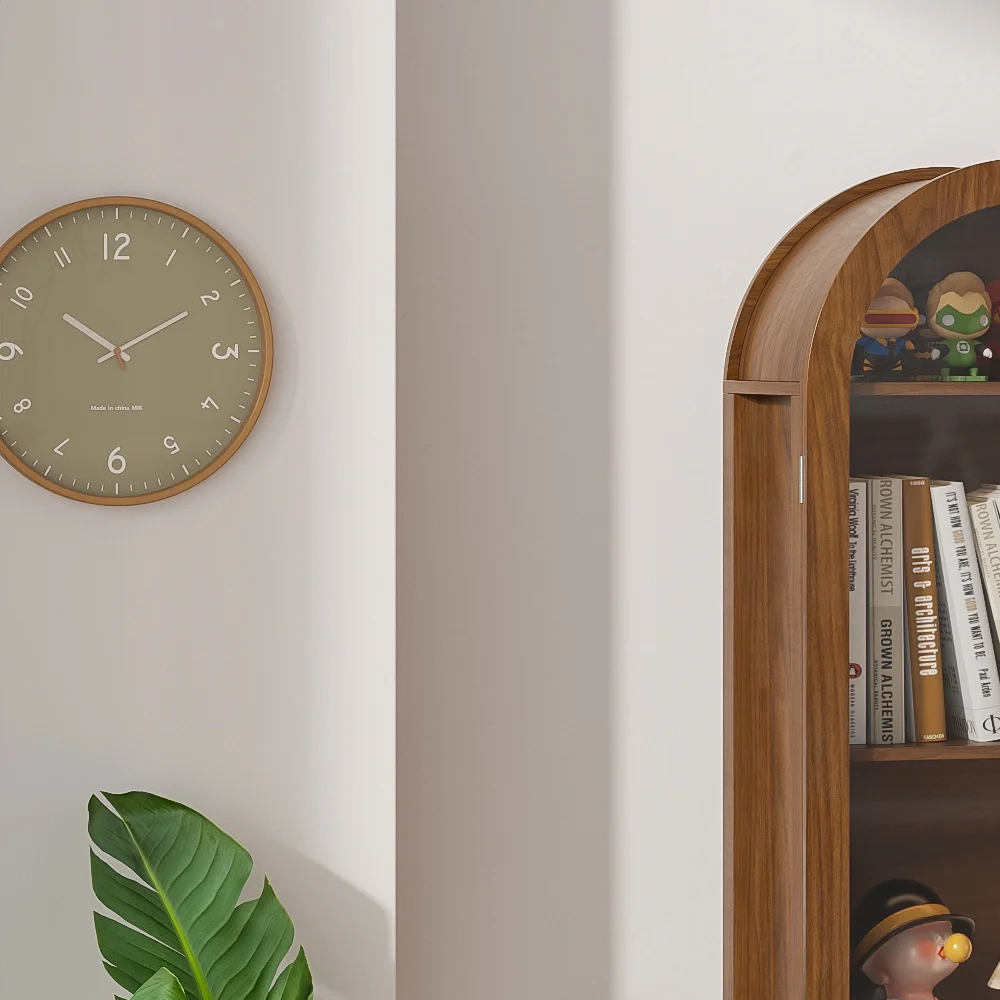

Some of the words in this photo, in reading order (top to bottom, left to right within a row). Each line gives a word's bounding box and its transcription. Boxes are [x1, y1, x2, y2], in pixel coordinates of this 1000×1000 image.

[103, 232, 131, 261] 12
[53, 246, 72, 268] 11
[9, 286, 34, 309] 10
[199, 289, 221, 307] 2
[0, 341, 24, 361] 9
[211, 342, 239, 360] 3
[13, 397, 32, 414] 8
[200, 396, 220, 411] 4
[53, 437, 70, 456] 7
[163, 435, 181, 455] 5
[107, 446, 126, 474] 6
[880, 480, 892, 519] ROWN
[948, 504, 959, 514] NOT
[950, 516, 962, 528] HOW
[976, 503, 994, 540] ROWN
[953, 530, 965, 544] GOOD
[880, 523, 893, 595] ALCHEMIST
[956, 545, 967, 556] YOU
[911, 547, 932, 574] arts
[962, 584, 974, 596] HOW
[965, 597, 977, 611] GOOD
[968, 613, 979, 624] YOU
[914, 595, 938, 676] architecture
[970, 625, 983, 641] WANT
[881, 620, 892, 670] GROWN
[974, 641, 984, 649] TO
[979, 668, 990, 680] Paul
[981, 682, 992, 698] Arden
[881, 674, 893, 744] ALCHEMIS
